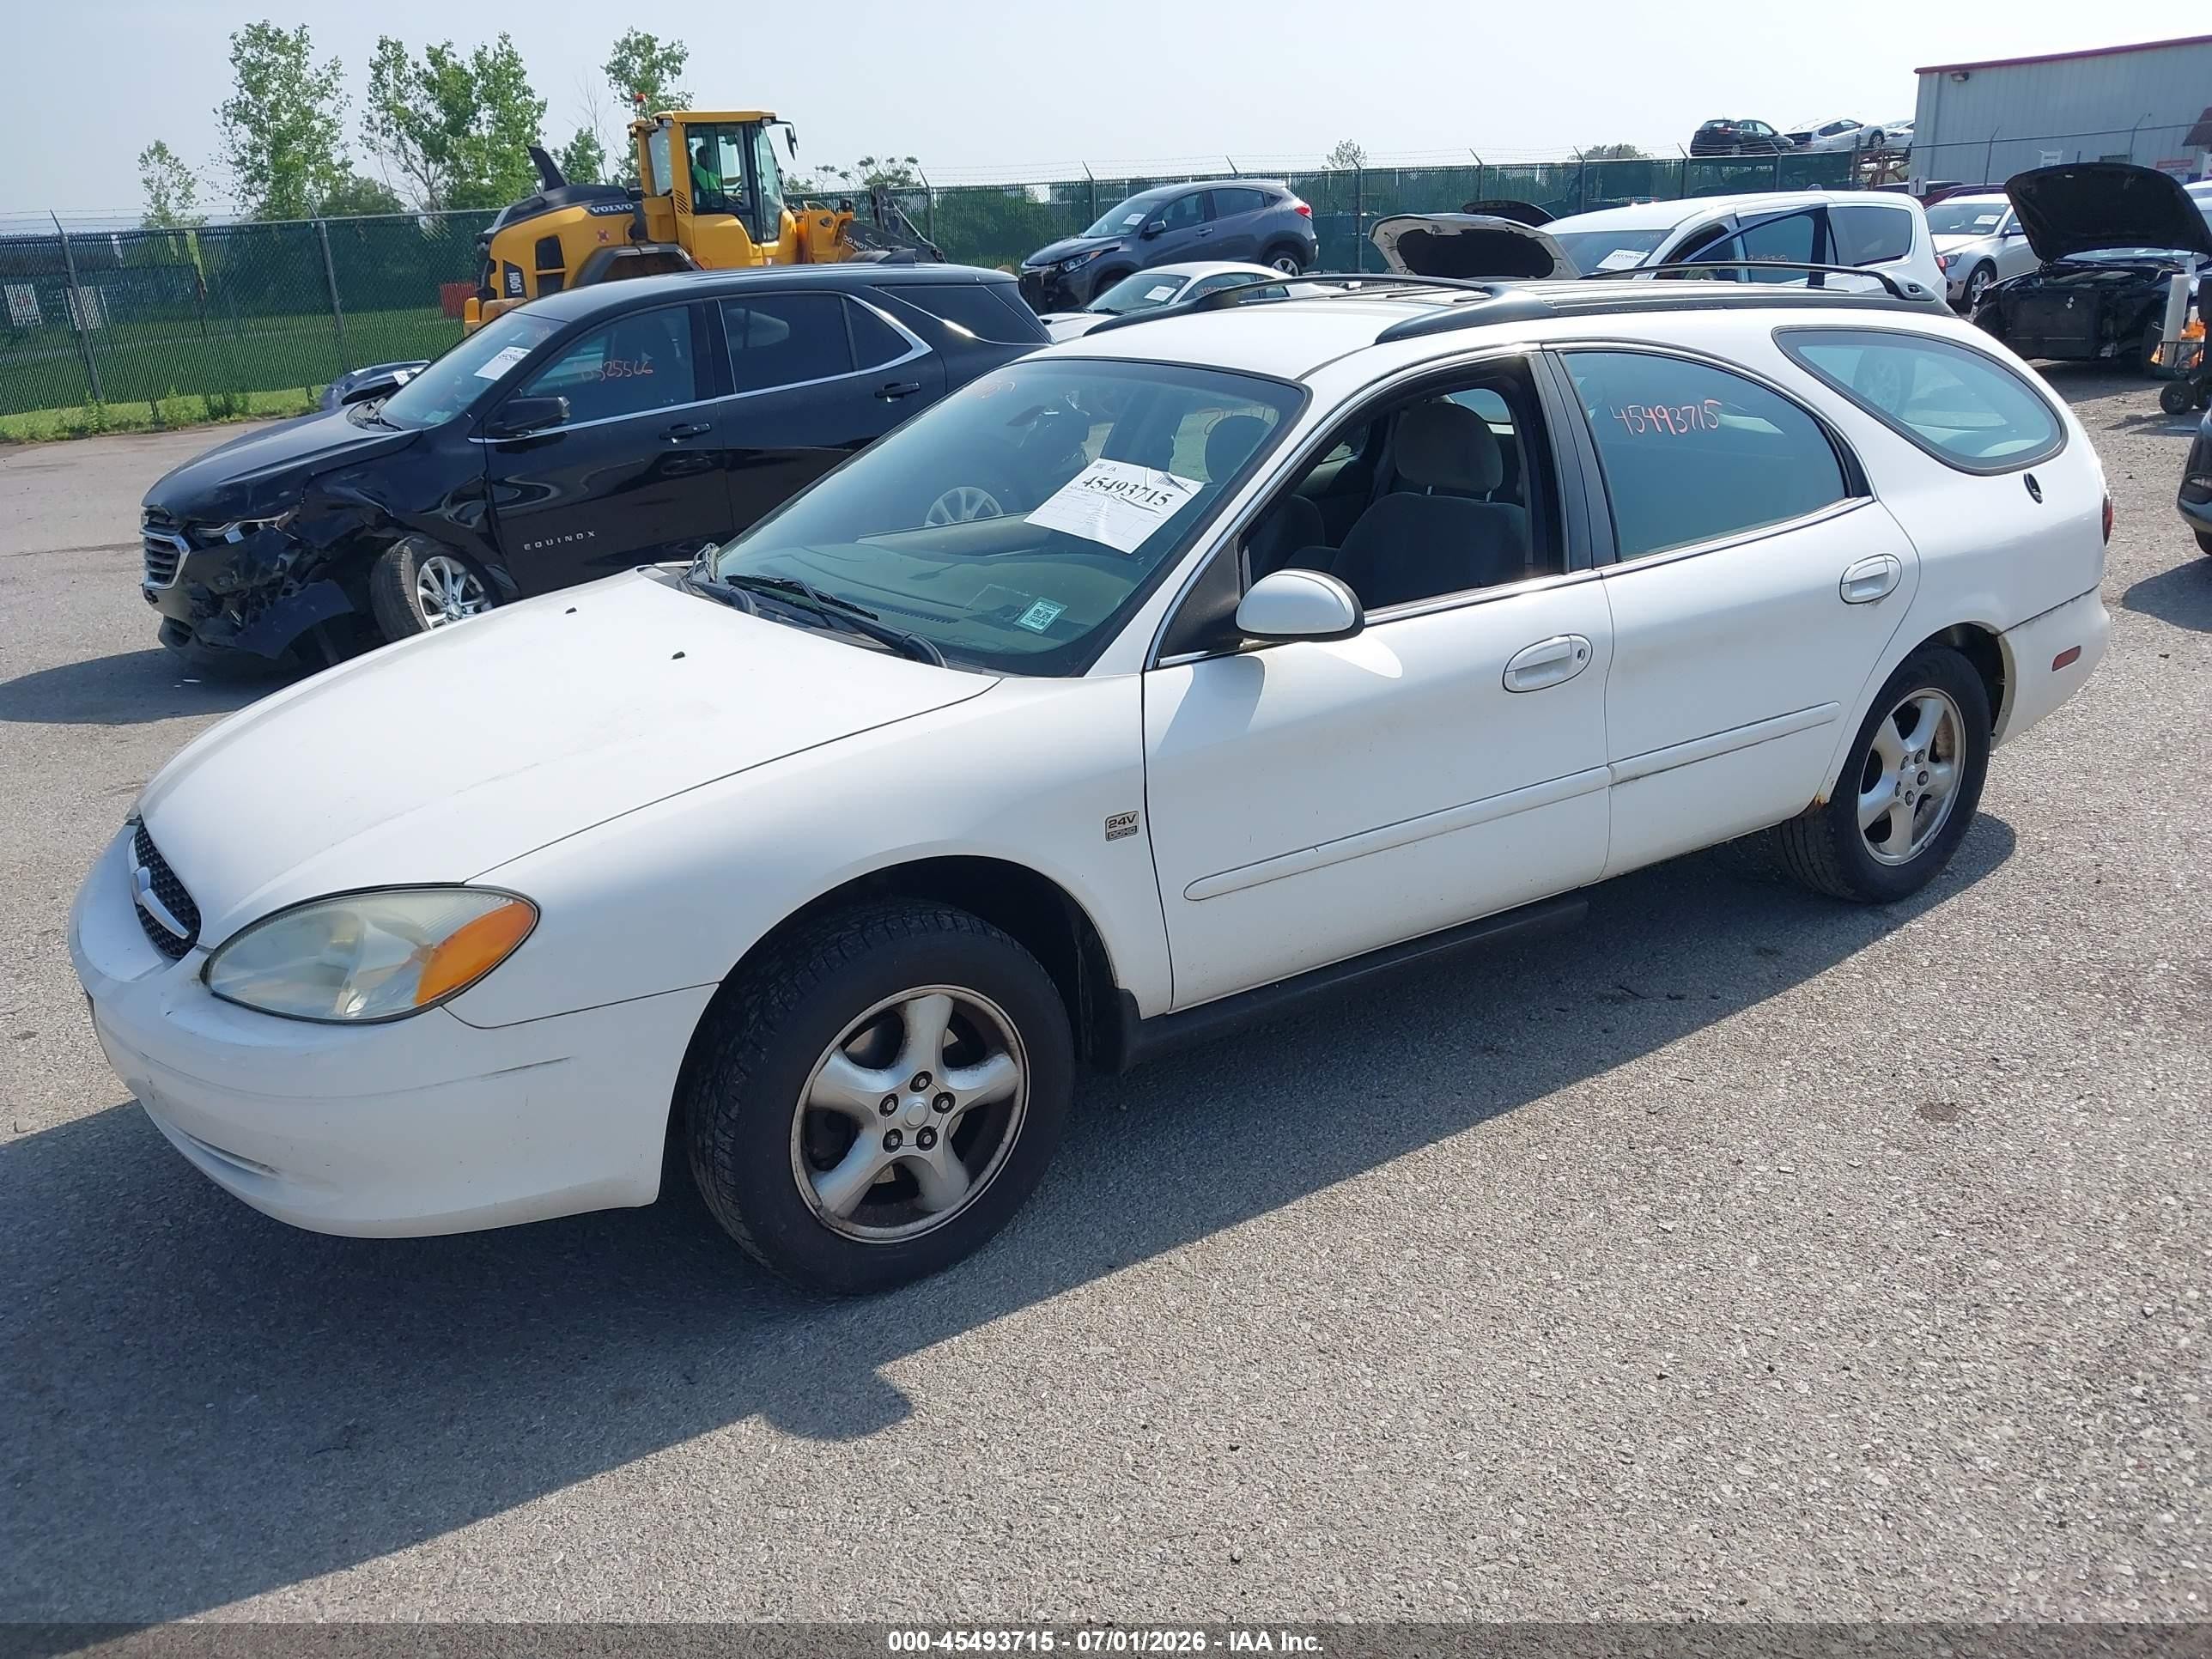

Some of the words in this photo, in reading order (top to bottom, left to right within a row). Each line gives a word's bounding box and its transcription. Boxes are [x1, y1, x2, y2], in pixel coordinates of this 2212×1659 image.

[1914, 177, 1920, 194] 1
[591, 203, 634, 214] VOLVO
[854, 240, 867, 251] NOT
[507, 272, 522, 294] L90H
[1609, 398, 1723, 435] 45493715
[1082, 475, 1175, 507] 45493715
[523, 531, 596, 550] EQUINOX
[1108, 813, 1138, 830] 24V
